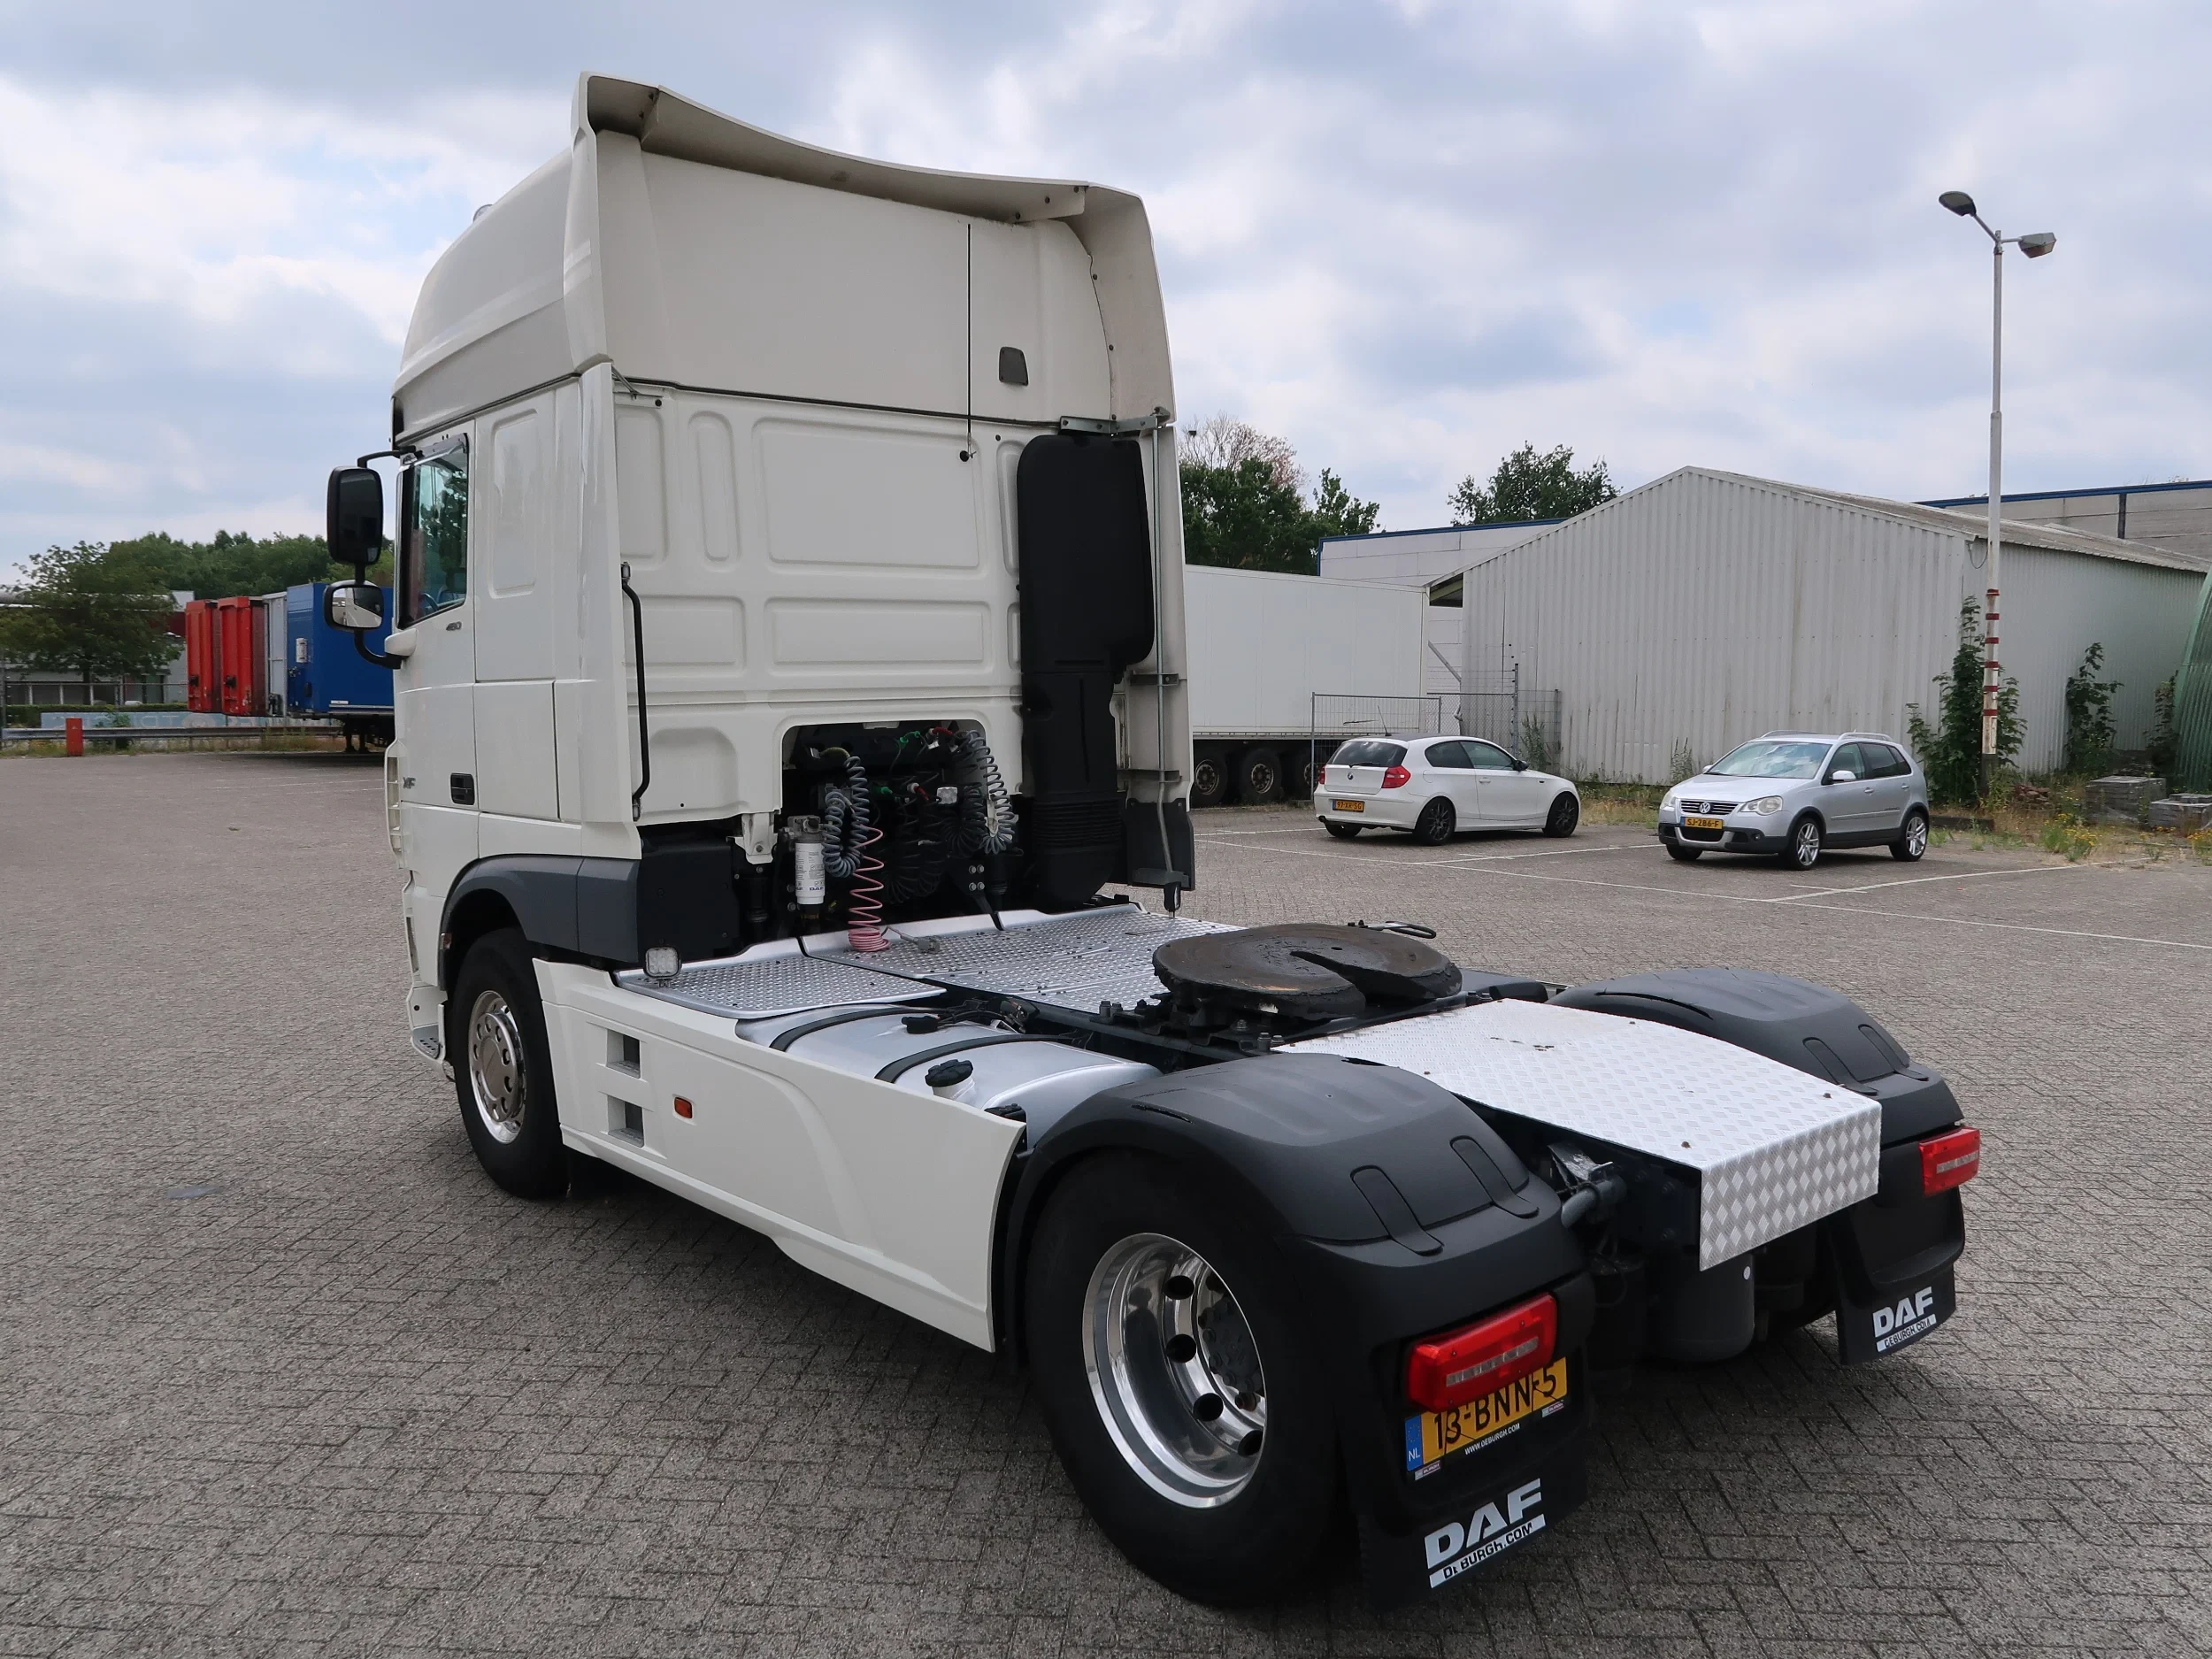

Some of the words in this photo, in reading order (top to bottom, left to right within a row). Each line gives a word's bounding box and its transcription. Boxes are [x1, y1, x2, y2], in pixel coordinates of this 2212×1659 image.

[1687, 818, 1719, 827] SJ-286-F
[1872, 1286, 1933, 1338] DAF
[1434, 1366, 1556, 1450] 13-BNN-5
[1408, 1448, 1421, 1462] NL
[1424, 1478, 1542, 1570] DAF
